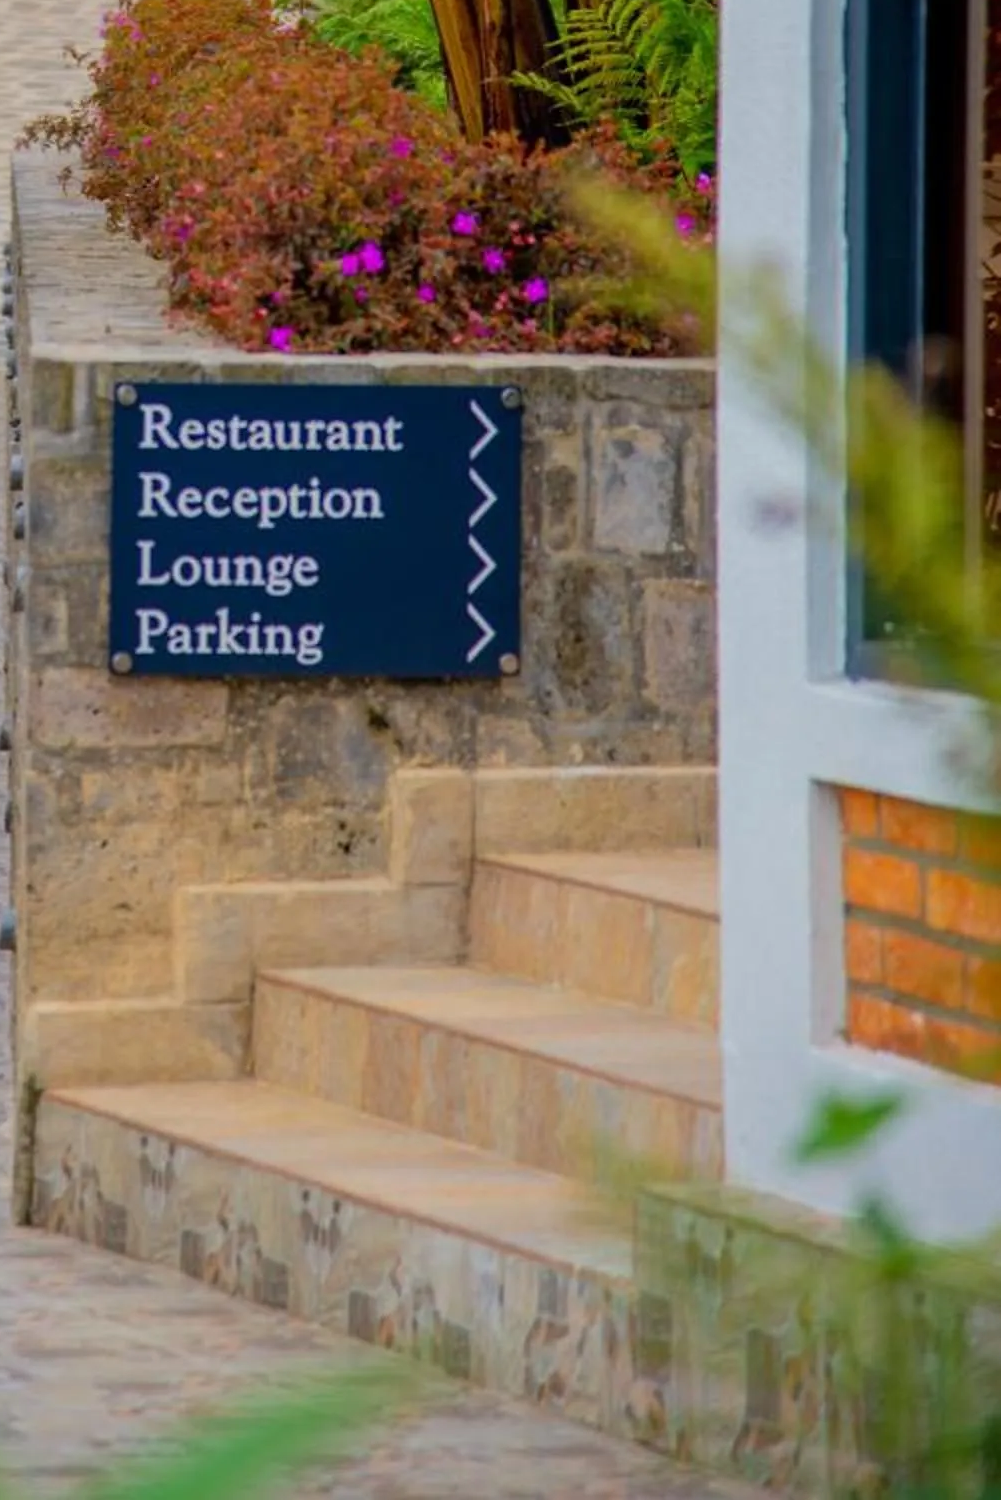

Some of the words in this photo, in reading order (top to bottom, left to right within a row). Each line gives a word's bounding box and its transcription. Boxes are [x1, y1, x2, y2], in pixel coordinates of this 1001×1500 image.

[138, 403, 403, 451] Restaurant
[137, 471, 384, 529] Reception
[136, 539, 319, 596] Lounge
[135, 607, 324, 665] Parking
